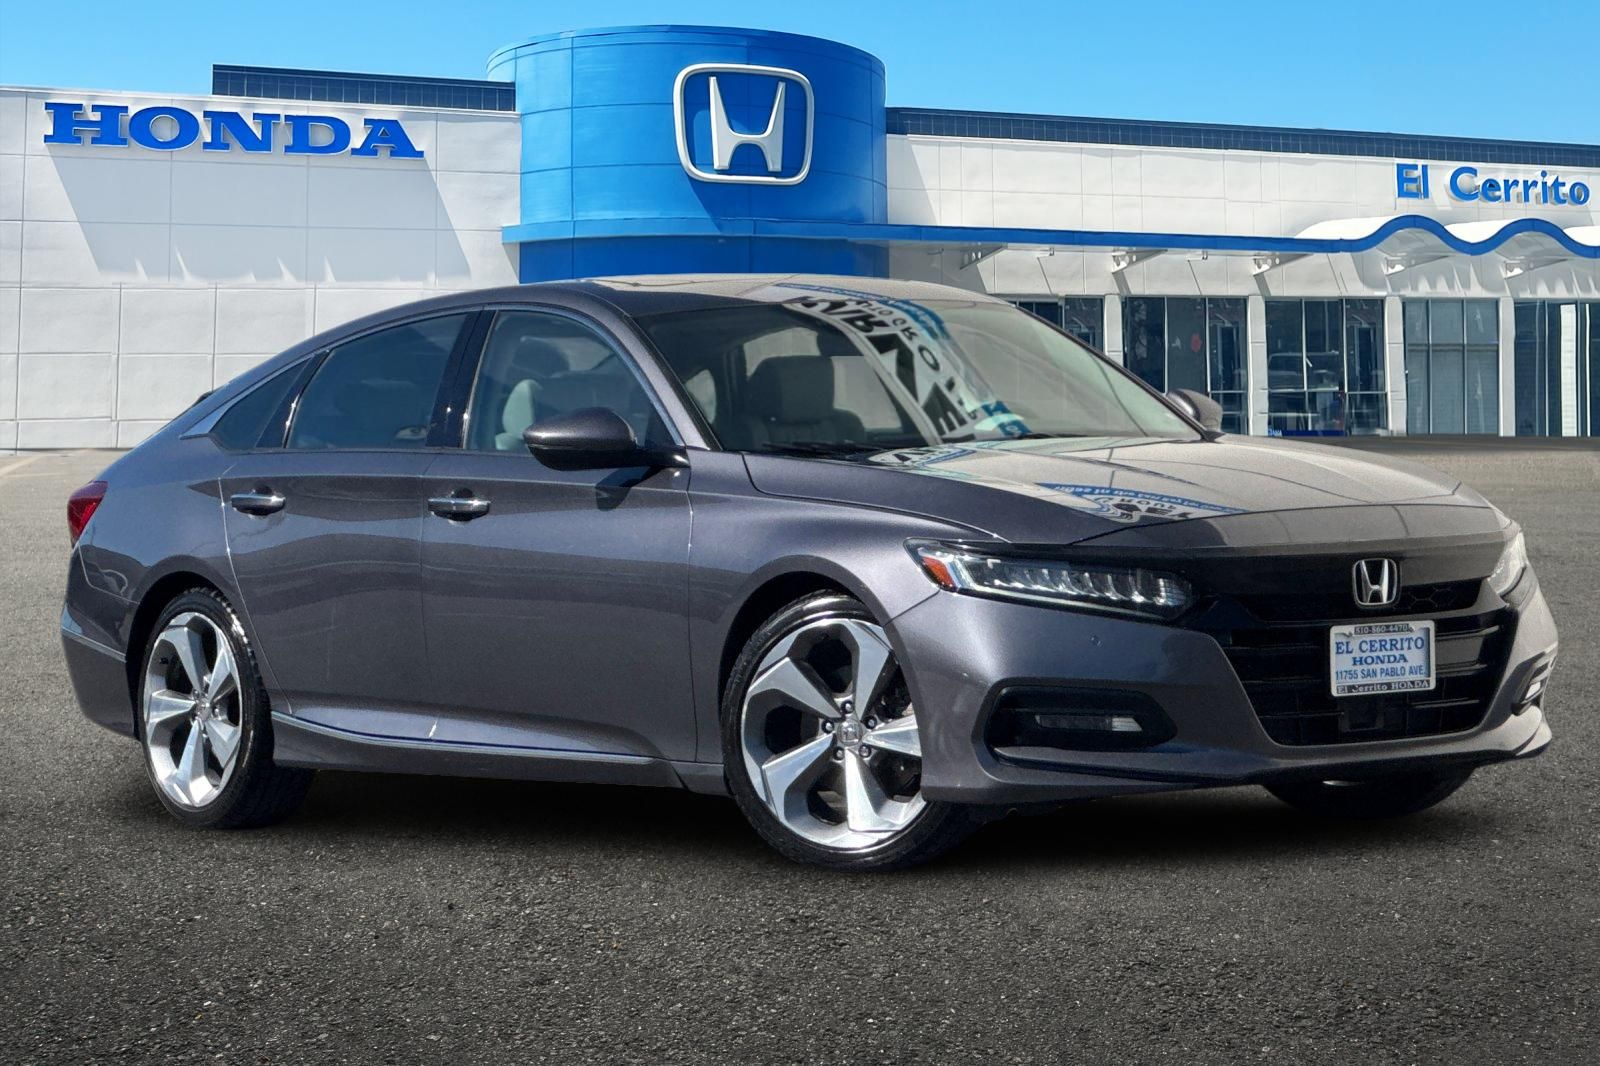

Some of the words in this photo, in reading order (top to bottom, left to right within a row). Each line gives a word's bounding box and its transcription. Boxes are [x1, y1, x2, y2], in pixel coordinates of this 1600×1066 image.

[43, 101, 425, 158] HONDA
[1396, 162, 1430, 199] El
[1449, 165, 1591, 206] Cerrito
[1335, 641, 1354, 655] EL
[1358, 636, 1425, 653] CERRITO
[1352, 653, 1408, 666] HONDA
[1336, 669, 1359, 681] 11755
[1360, 668, 1377, 679] SAN
[1380, 666, 1406, 677] PABLO
[1337, 686, 1349, 694] El
[1391, 680, 1429, 690] HONDA
